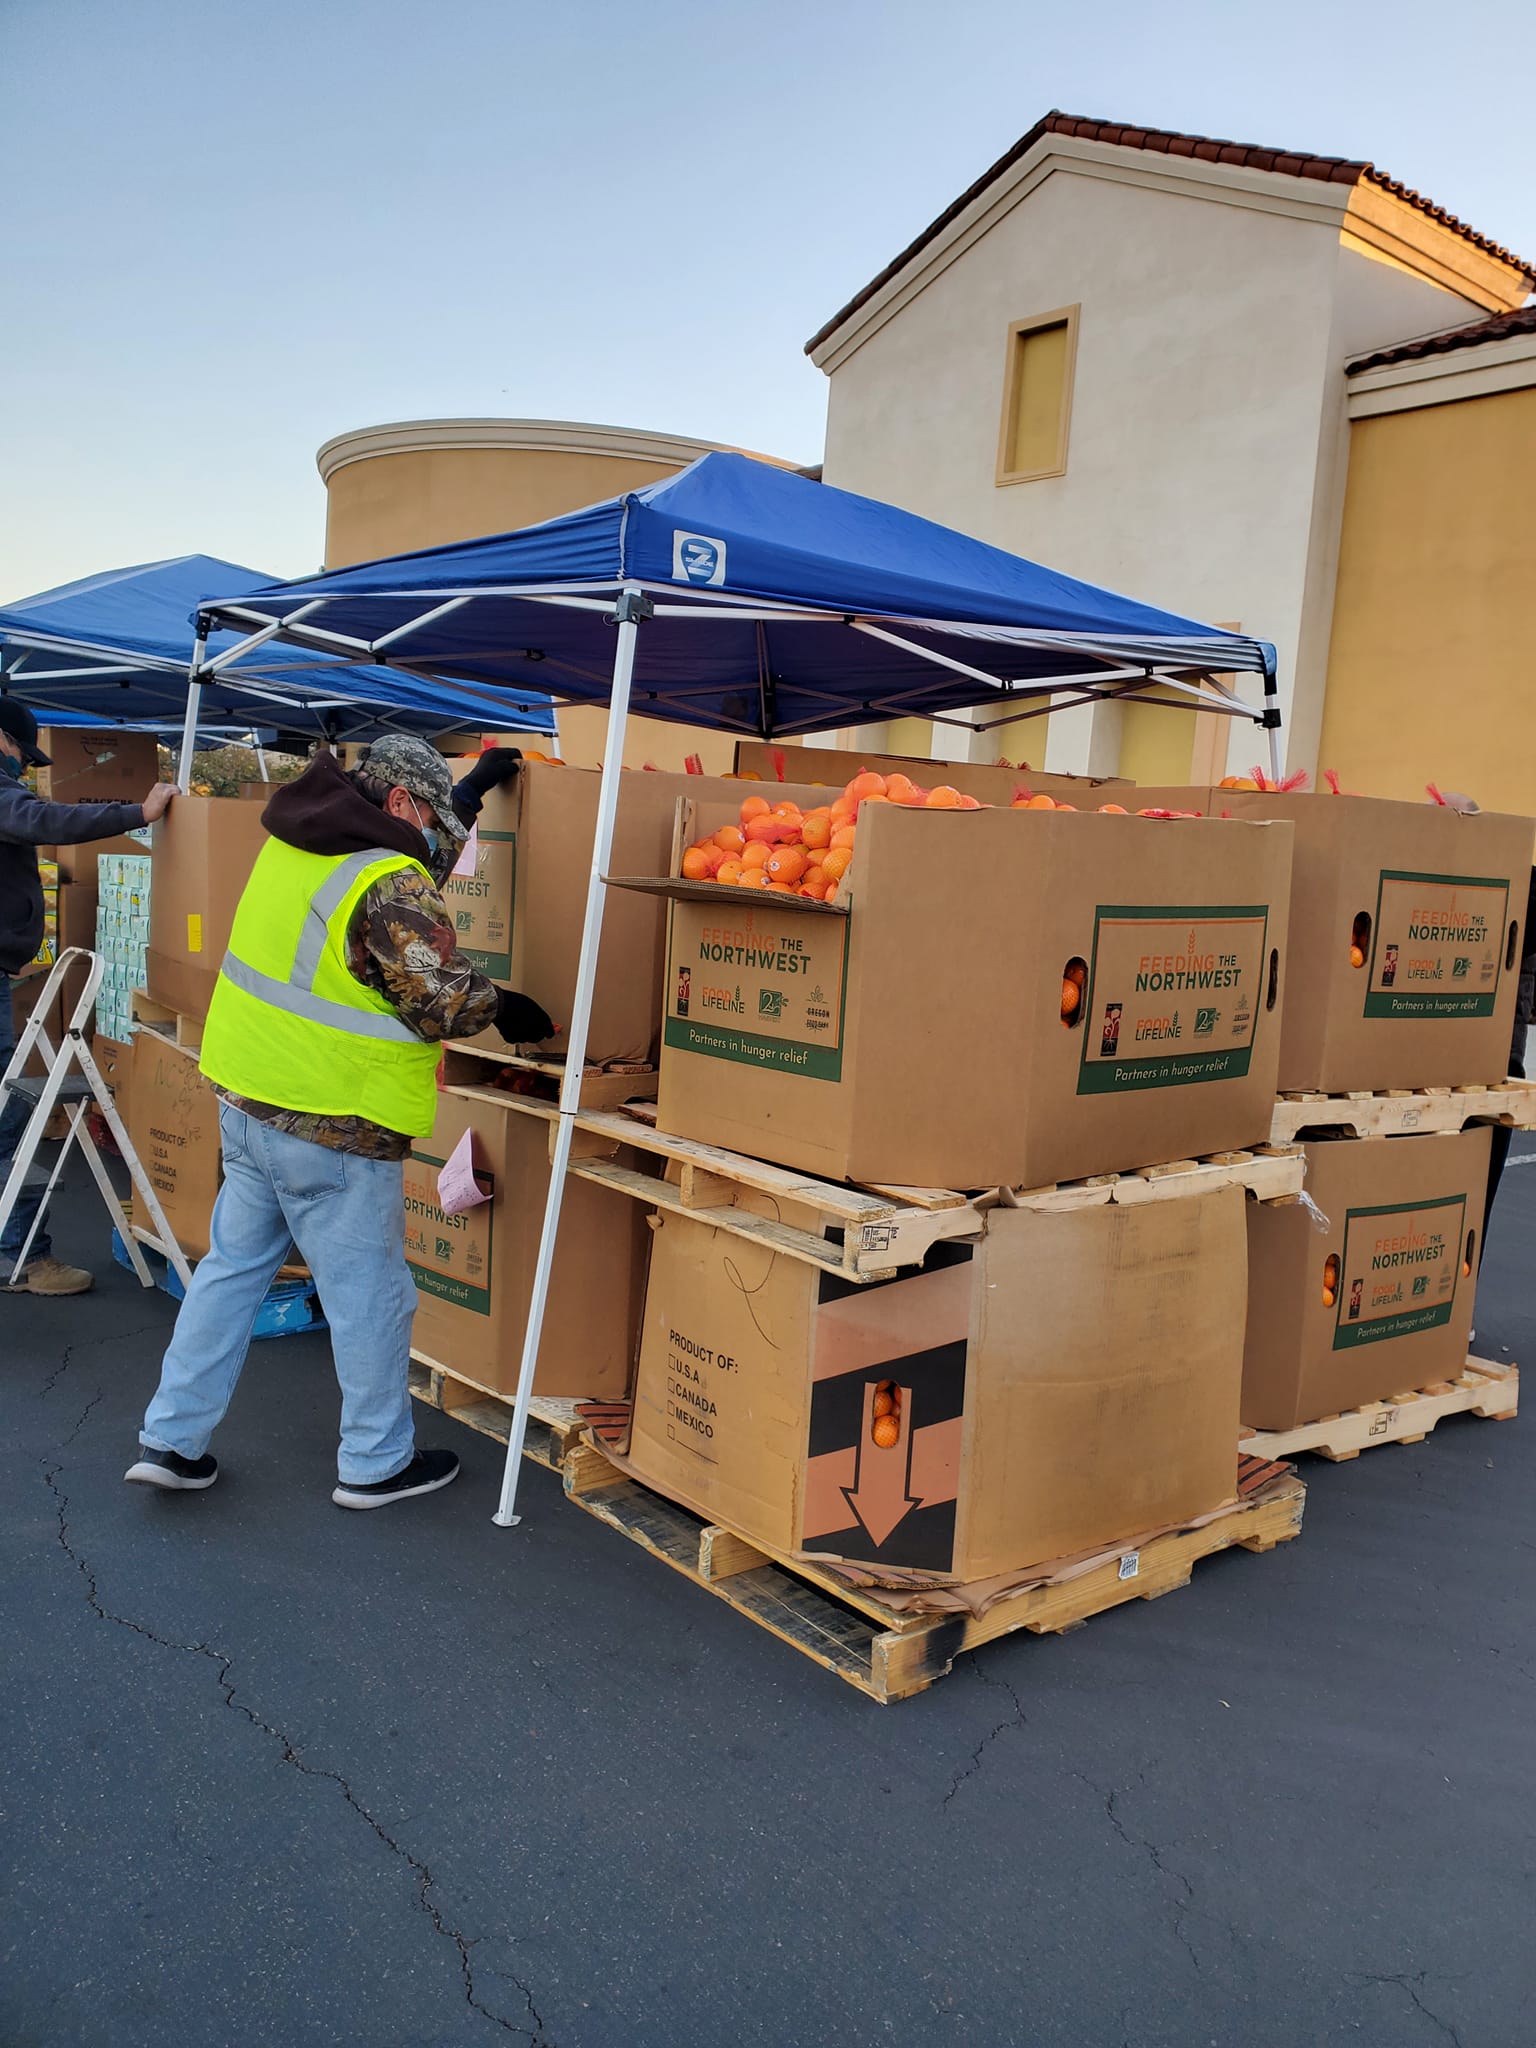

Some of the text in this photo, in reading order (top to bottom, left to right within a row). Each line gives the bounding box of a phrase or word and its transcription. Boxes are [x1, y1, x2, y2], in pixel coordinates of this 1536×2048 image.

[79, 797, 133, 805] CRACKRS
[474, 870, 485, 880] HE
[446, 880, 490, 897] HWEST
[1411, 909, 1485, 926] FEEDING THE
[702, 927, 803, 953] FEEDING THE
[1408, 924, 1488, 943] NORTHWEST
[700, 943, 811, 974] NORTHWEST
[1139, 954, 1237, 974] FEEDING THE
[1408, 959, 1435, 970] FOOD
[1135, 968, 1242, 992] NORTHWEST
[1407, 969, 1443, 980] LIFELINE
[702, 986, 732, 1002] FOOD
[702, 994, 745, 1014] LIFELINE
[807, 1007, 830, 1018] OREGON
[1392, 998, 1479, 1012] Partners in hunger relief
[1135, 1026, 1182, 1041] LIFELINE
[1136, 1018, 1170, 1031] FOOD
[689, 1029, 808, 1065] Partners in hunger relief
[1114, 1056, 1229, 1081] Partners in hunger relief
[150, 1128, 177, 1144] PRODUCT
[153, 1162, 176, 1177] CANADA
[154, 1178, 174, 1193] MEXICO
[404, 1180, 441, 1205] EEDIN
[404, 1197, 468, 1231] ORTHWEST
[404, 1237, 426, 1254] FELINE
[1375, 1232, 1442, 1252] FEEDING THE
[1372, 1244, 1445, 1270] NORTHWEST
[425, 1273, 448, 1292] hunger
[450, 1286, 468, 1299] relief
[1373, 1284, 1395, 1295] FOOD
[1371, 1292, 1403, 1307] LIFELINE
[1357, 1310, 1437, 1338] Partners in hunger relief
[670, 1329, 738, 1374] PRODUCT OF:
[676, 1359, 699, 1384] U.S.A
[675, 1383, 717, 1417] CANADA
[675, 1406, 714, 1439] MEXICO
